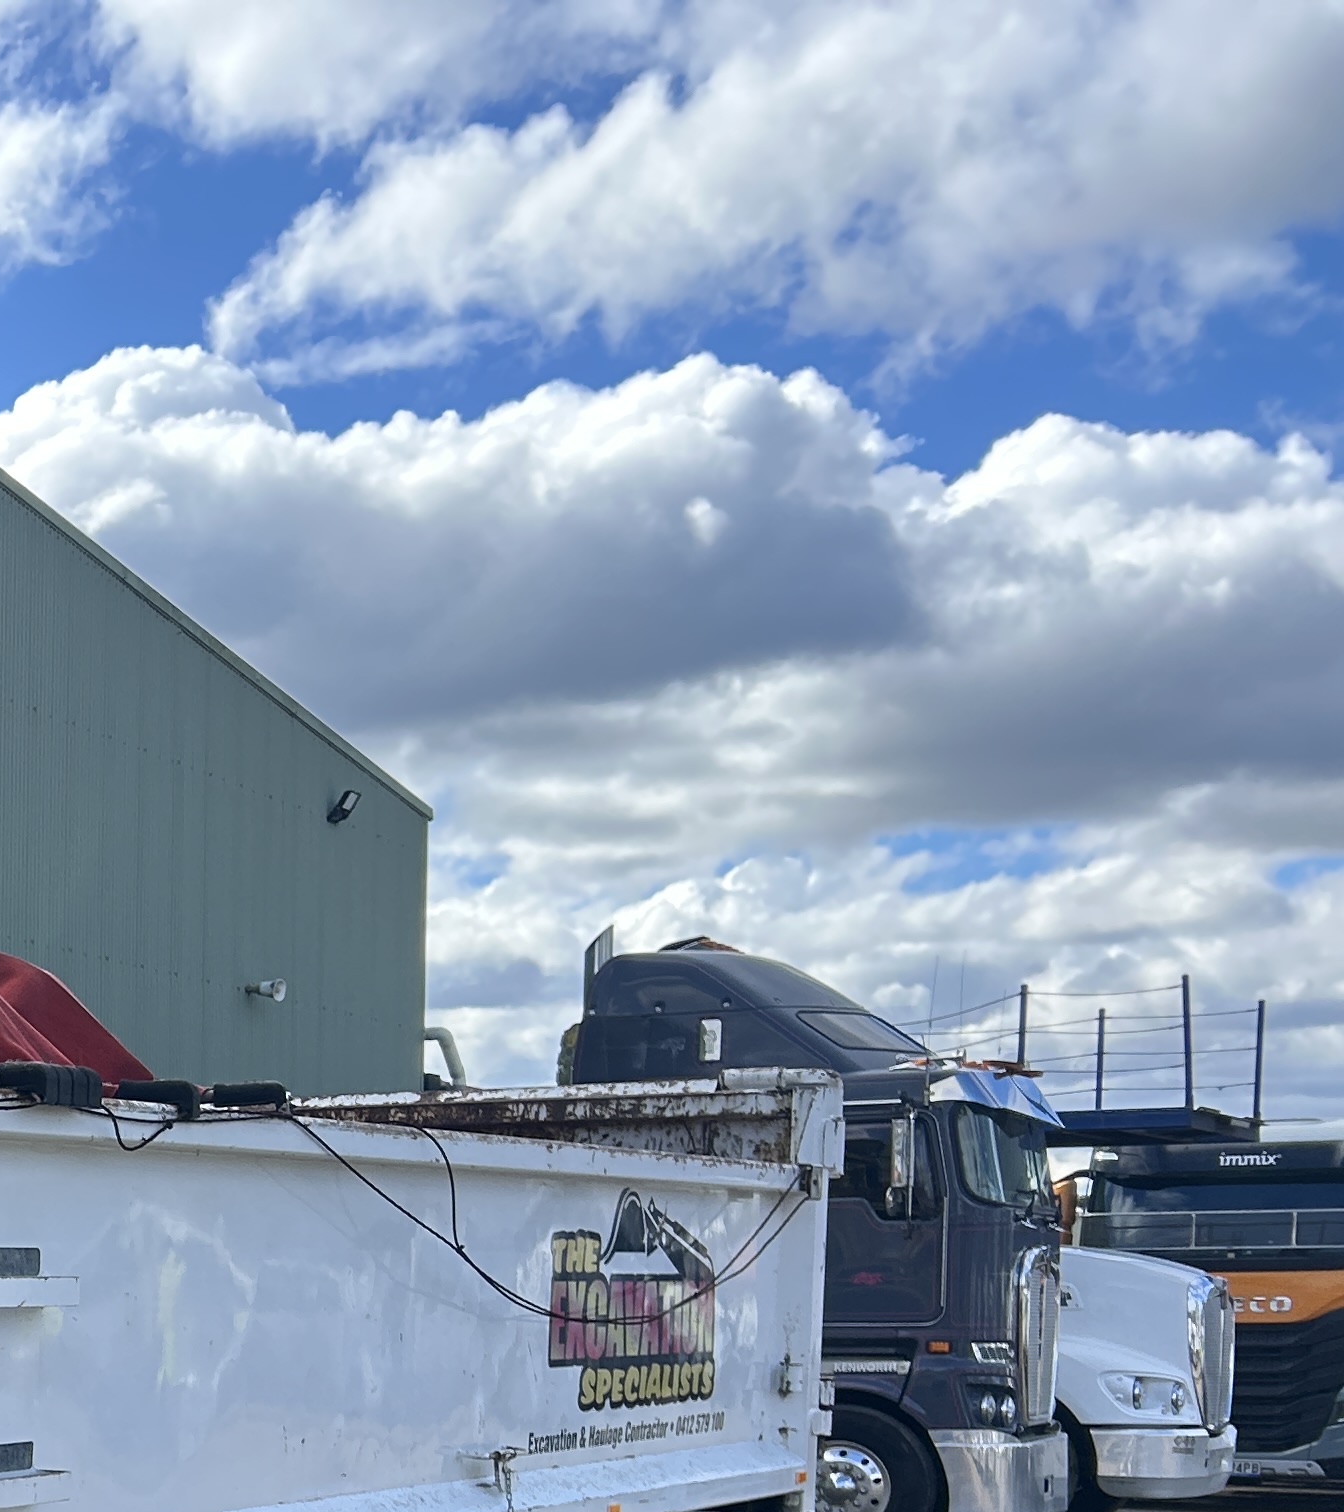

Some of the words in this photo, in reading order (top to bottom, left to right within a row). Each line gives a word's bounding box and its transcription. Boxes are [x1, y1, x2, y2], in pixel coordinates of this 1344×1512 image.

[1219, 1151, 1278, 1166] immix
[552, 1233, 601, 1275] THE
[550, 1278, 714, 1361] EXCAVATION
[579, 1361, 714, 1408] SPECIALISTS
[834, 1361, 898, 1373] KENWORTH
[528, 1428, 577, 1455] Excavation
[579, 1426, 586, 1448] &
[589, 1424, 623, 1449] Haulage
[625, 1417, 668, 1443] Contractor
[676, 1415, 693, 1436] 0412
[695, 1413, 710, 1434] 579
[1233, 1462, 1260, 1474] 4PB
